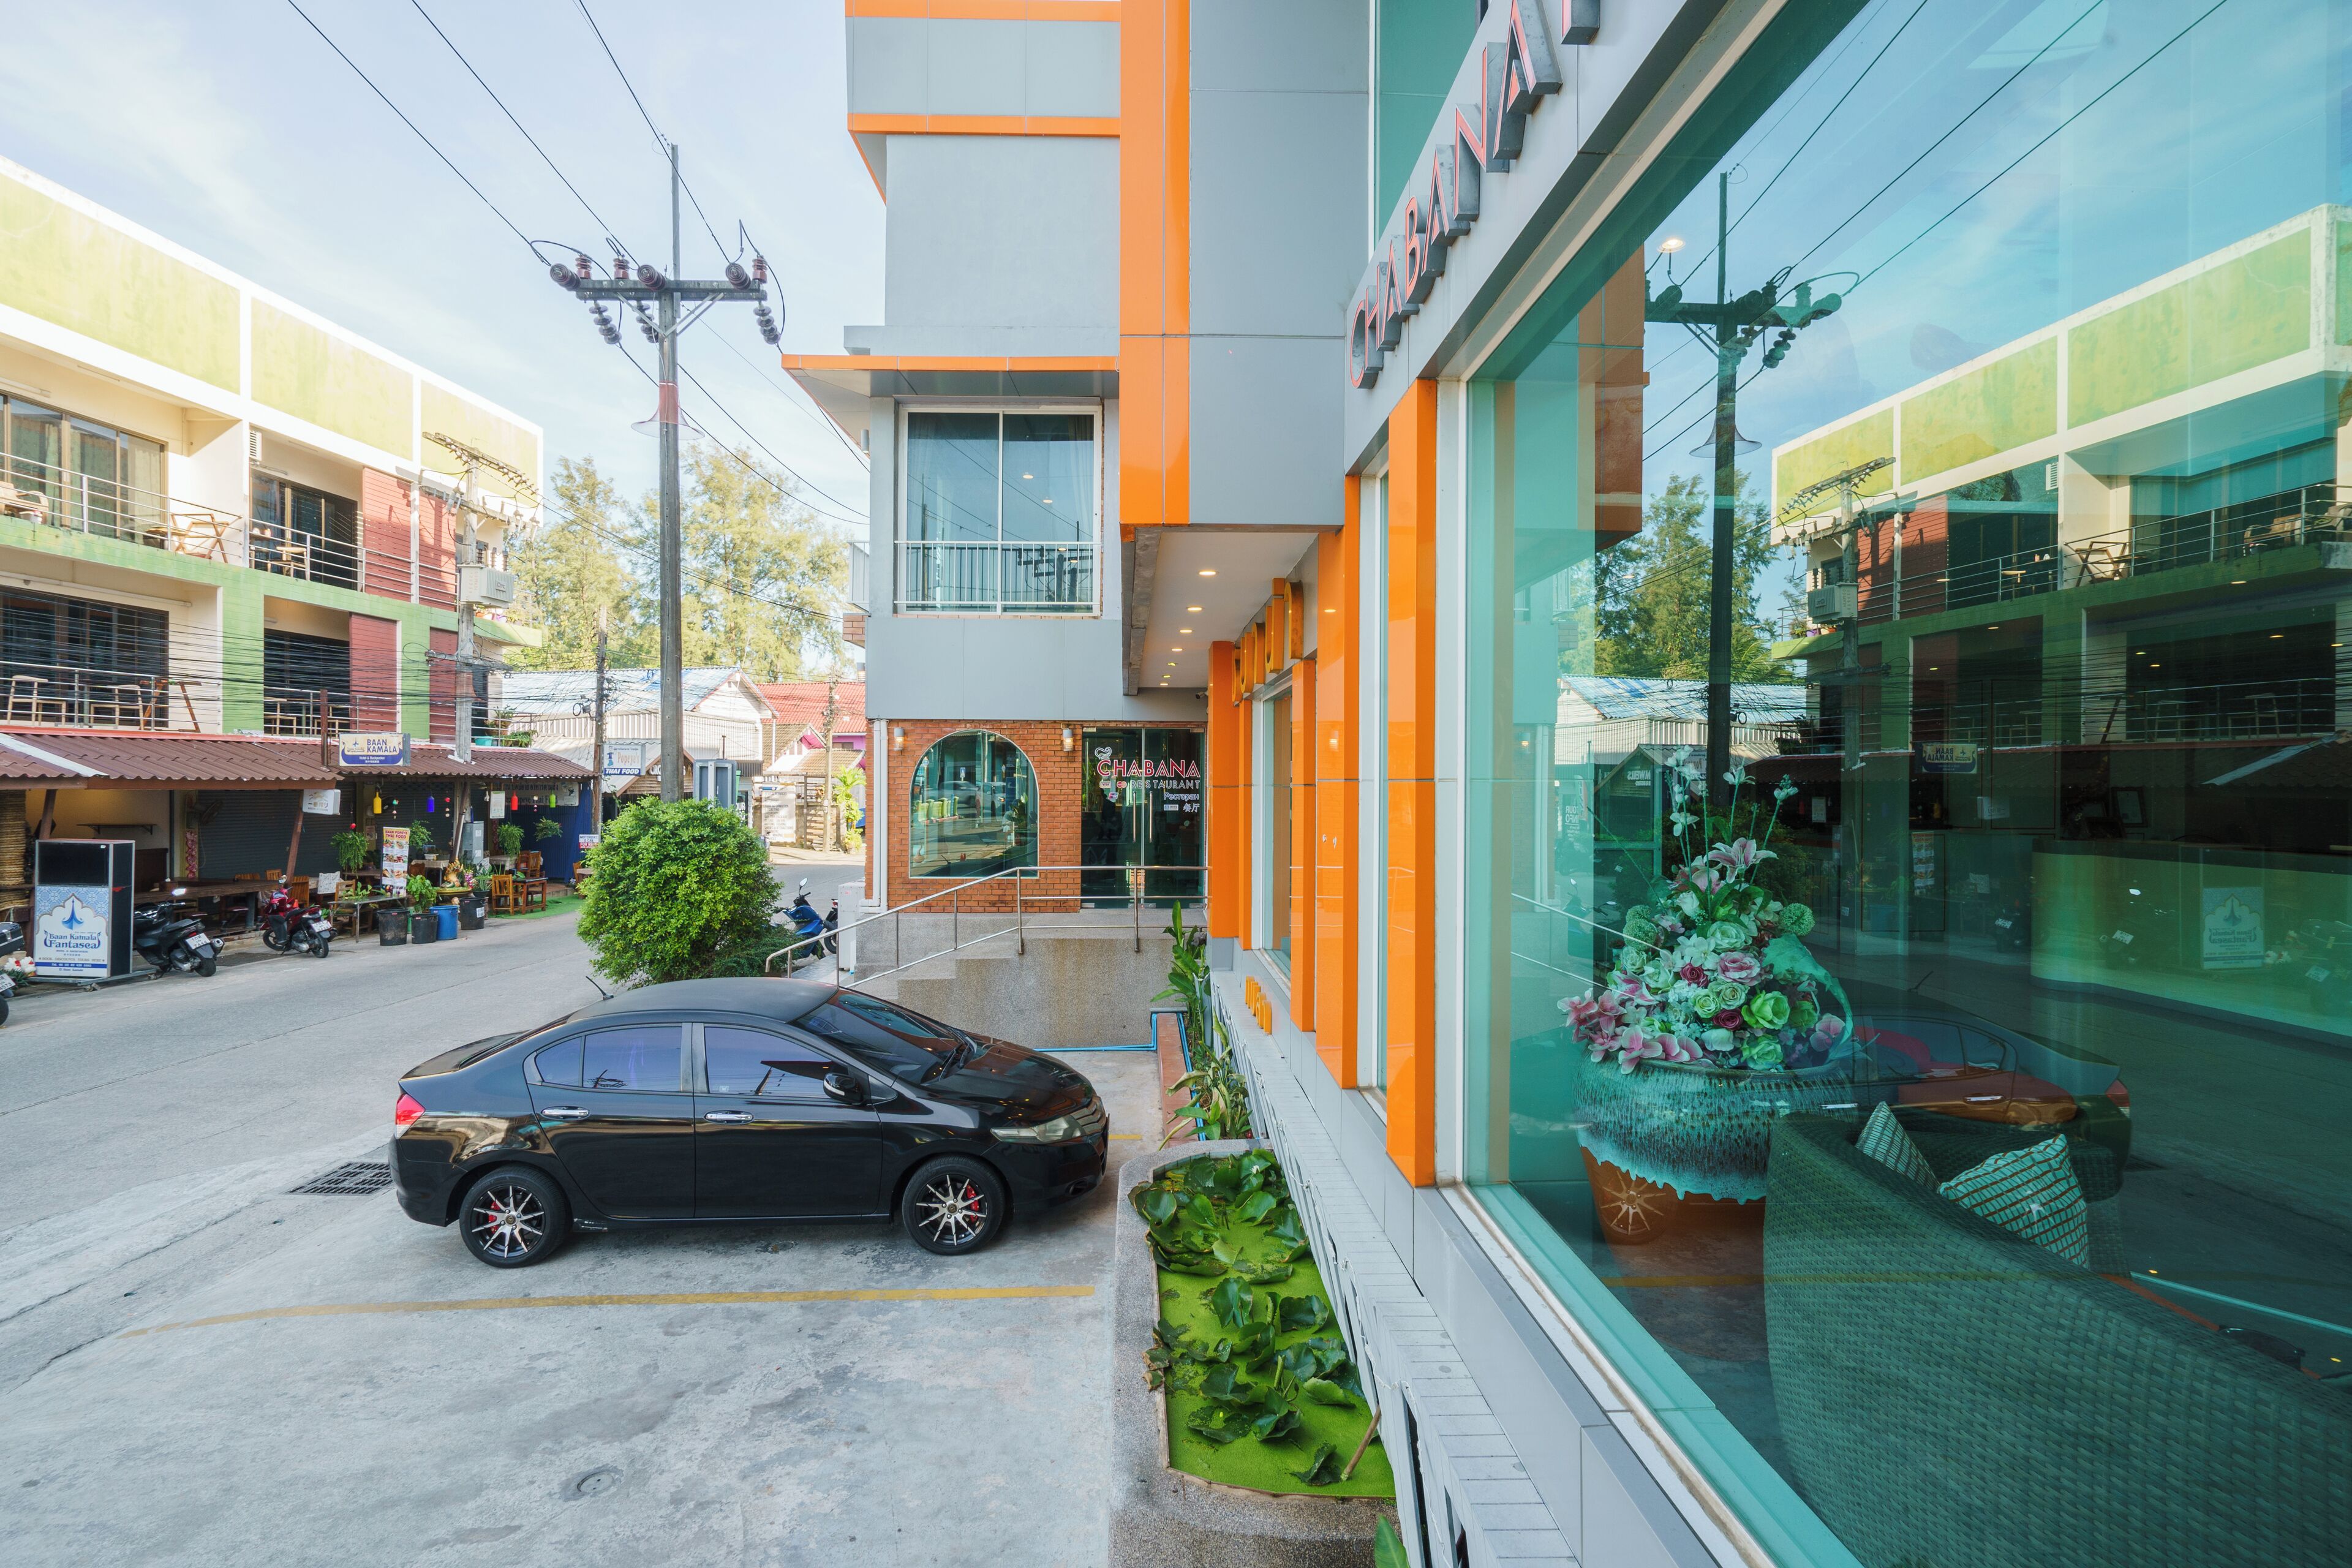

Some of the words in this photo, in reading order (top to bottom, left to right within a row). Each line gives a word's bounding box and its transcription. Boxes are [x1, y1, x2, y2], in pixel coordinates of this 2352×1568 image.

[1350, 0, 1562, 389] CHABANA
[1097, 758, 1200, 778] CHABANA
[1131, 779, 1200, 789] RESTAURANT
[1164, 792, 1199, 801] Ресторан
[1183, 802, 1199, 813] 餐厅
[49, 940, 97, 949] Fantasea
